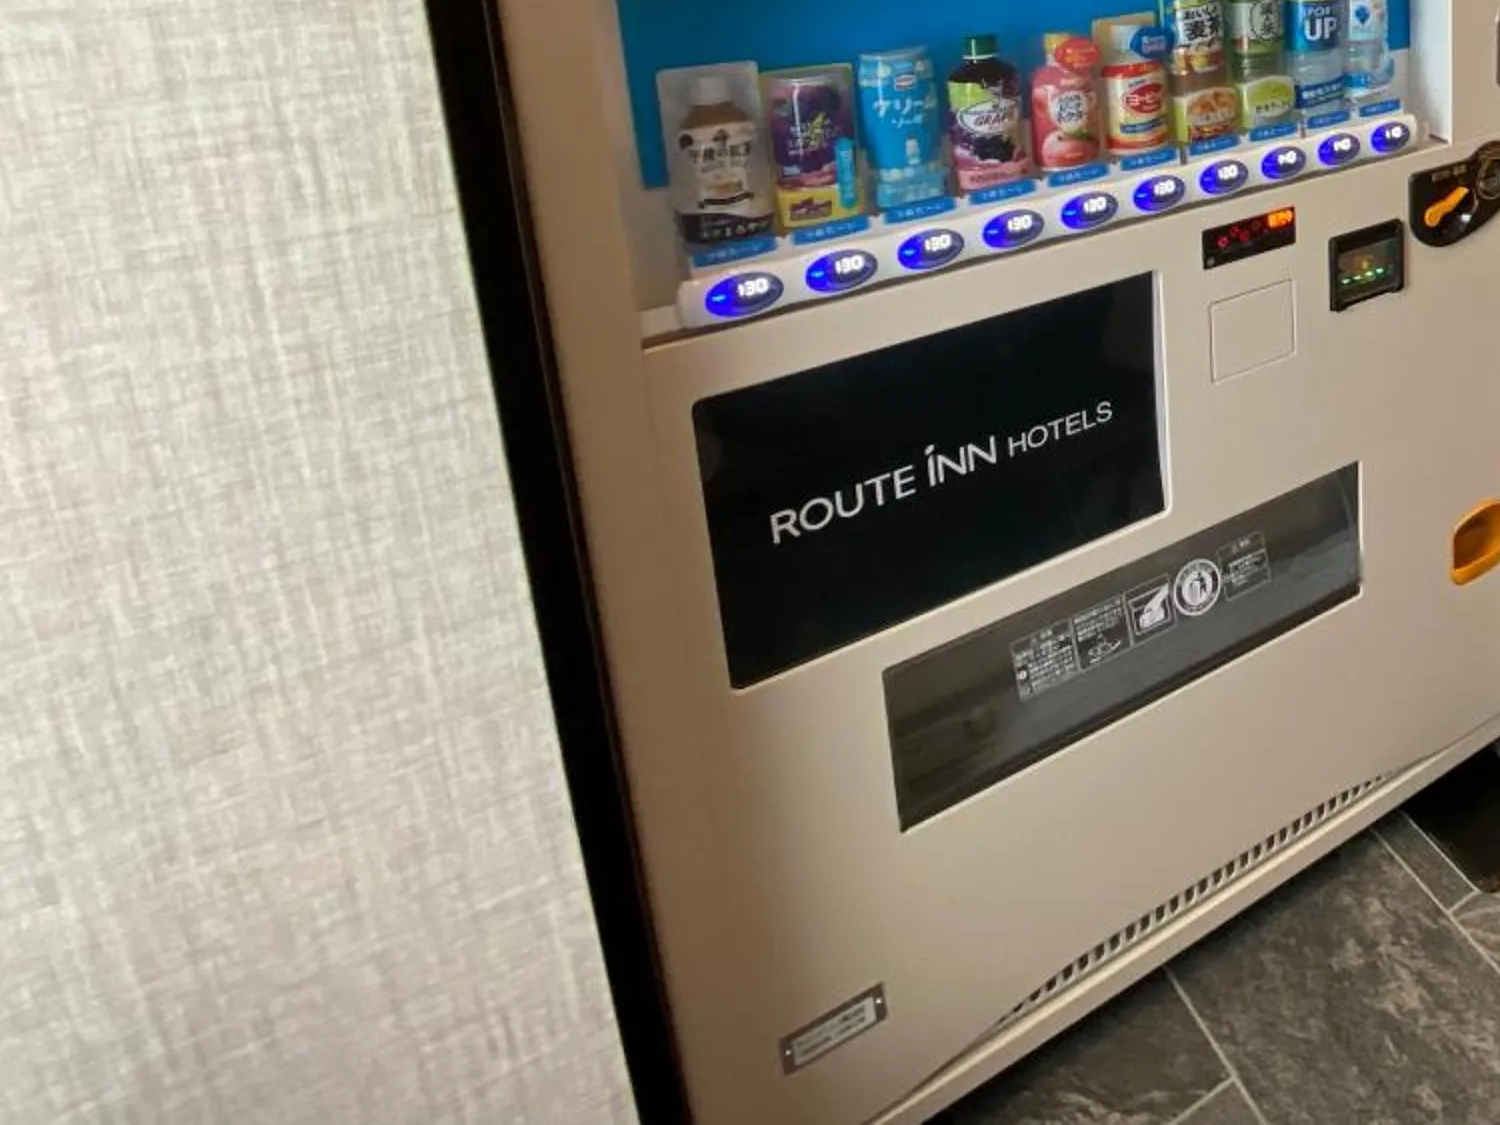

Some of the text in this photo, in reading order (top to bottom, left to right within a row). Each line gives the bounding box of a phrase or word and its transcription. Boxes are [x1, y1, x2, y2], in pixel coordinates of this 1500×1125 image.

[924, 233, 953, 252] 130
[834, 254, 866, 274] 130
[737, 276, 771, 297] 130
[771, 465, 915, 543] ROUTE
[1008, 402, 1112, 456] HOTELS
